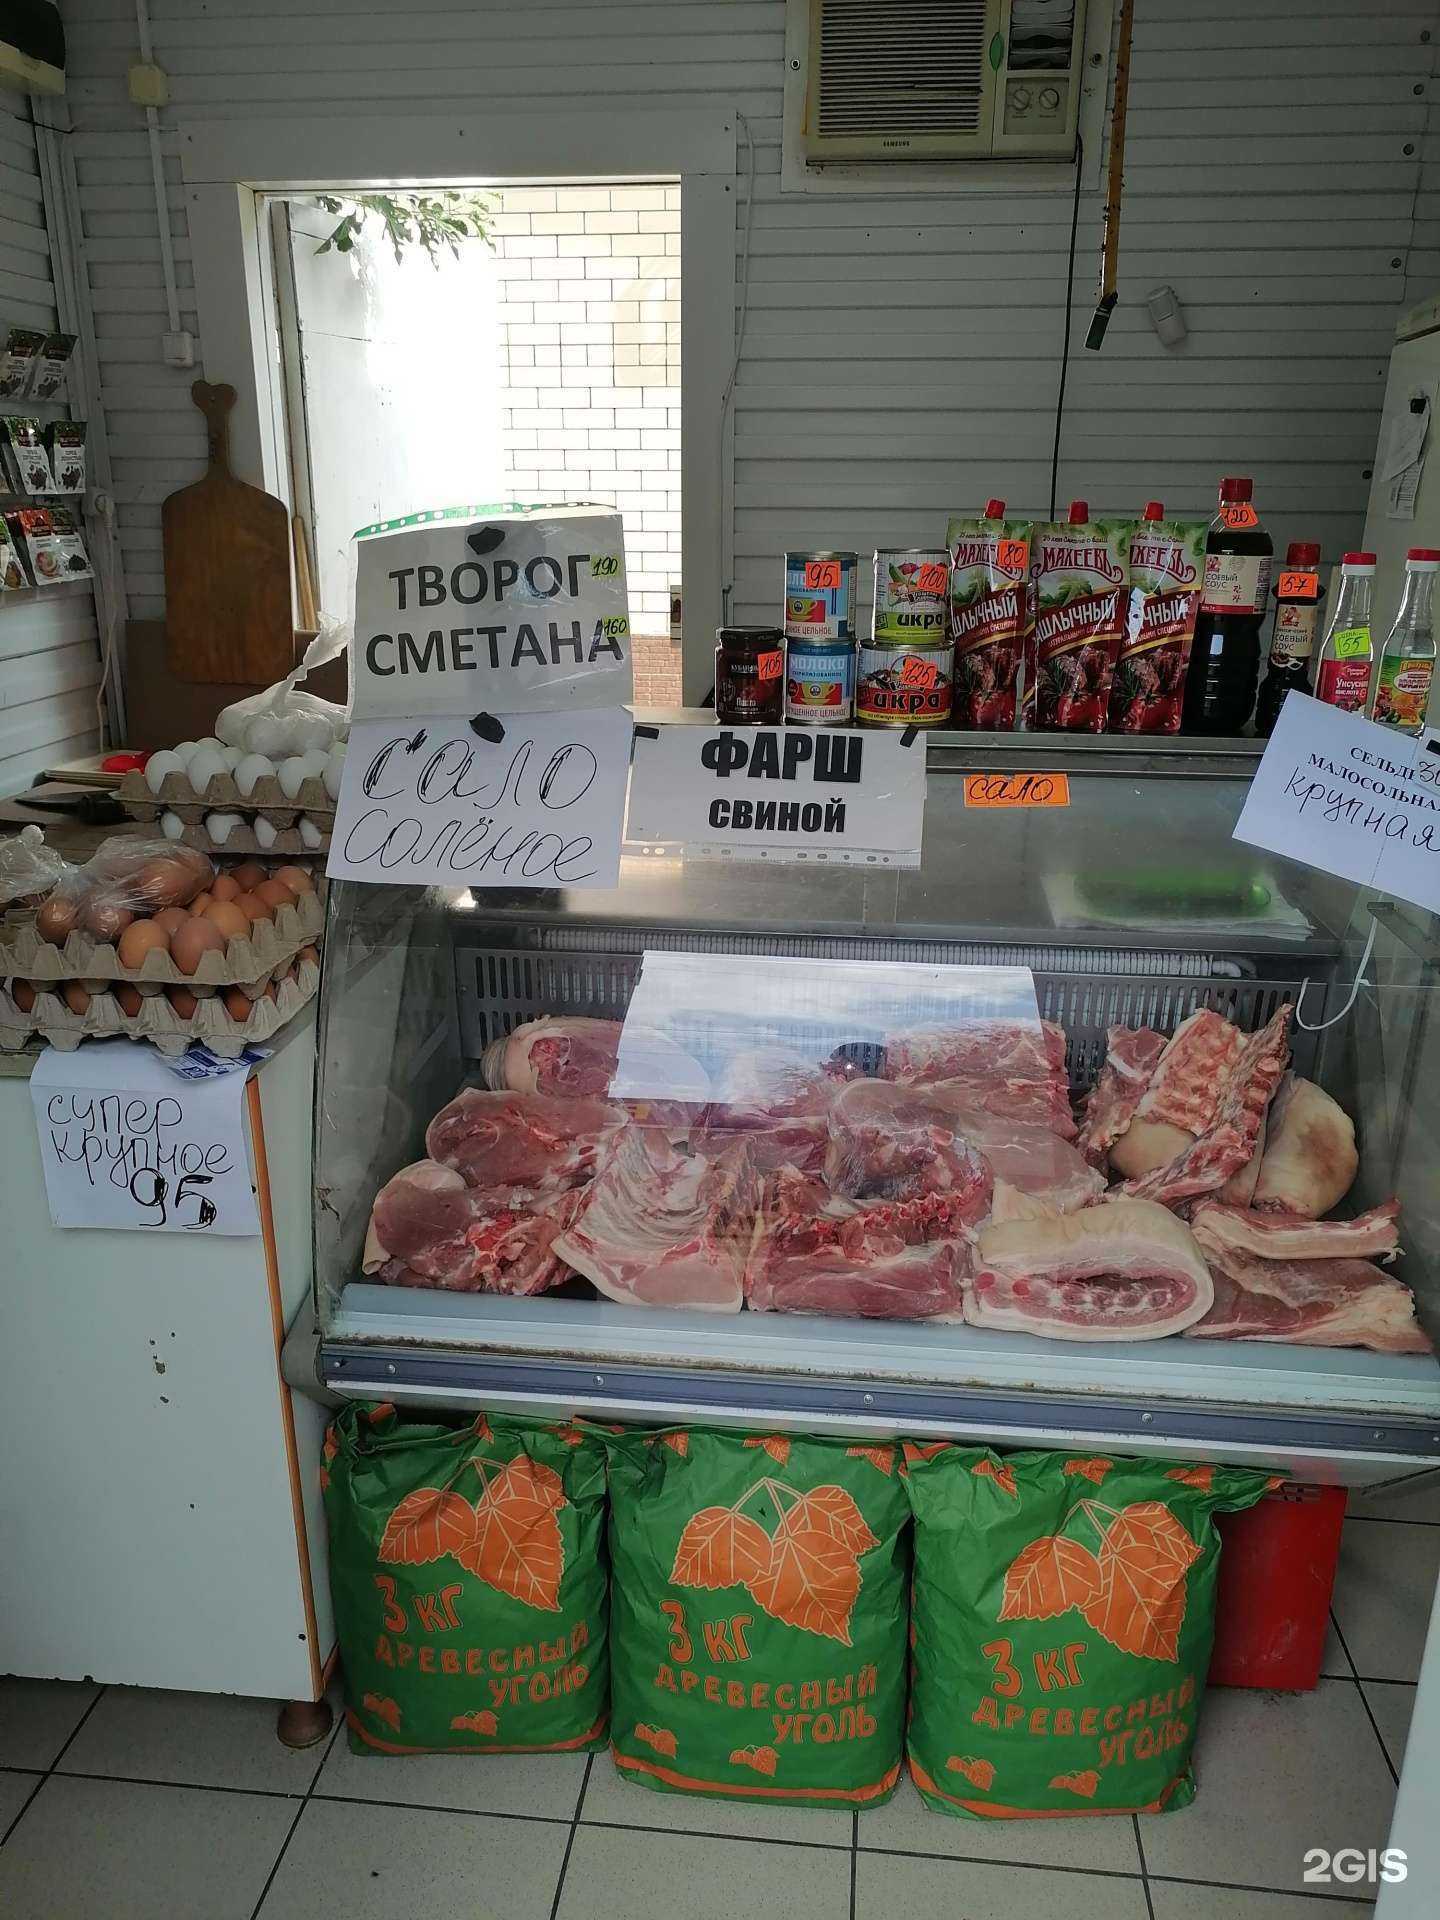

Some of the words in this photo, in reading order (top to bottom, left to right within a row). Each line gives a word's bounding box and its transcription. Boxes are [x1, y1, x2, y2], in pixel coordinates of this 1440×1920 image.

[592, 558, 618, 577] 190
[810, 563, 836, 589] 95
[1003, 543, 1025, 567] 80
[389, 555, 590, 609] ТВОРОГ
[1205, 580, 1228, 589] СОУС
[1282, 576, 1309, 593] 57
[365, 618, 624, 677] СМЕТАНА
[603, 618, 627, 636] 160
[700, 731, 863, 783] ФАРШ
[1308, 753, 1440, 812] МАЛОСОЛЬНА
[708, 798, 846, 833] СВИНОЙ
[130, 1167, 217, 1229] 95
[374, 1575, 408, 1634] 3
[413, 1583, 464, 1632] КГ
[374, 1621, 590, 1675] ДРЕВЕСНЫЙ
[660, 1599, 694, 1663] 3
[703, 1614, 754, 1663] КГ
[489, 1663, 590, 1707] УГОЛЬ
[654, 1663, 878, 1709] ДРЕВЕСНЫЙ
[981, 1638, 1024, 1697] 3
[1033, 1641, 1088, 1692] КГ
[772, 1703, 878, 1745] УГОЛЬ
[972, 1673, 1196, 1735] ДРЕВЕСНЫЙ
[1099, 1720, 1189, 1767] УГОЛЬ
